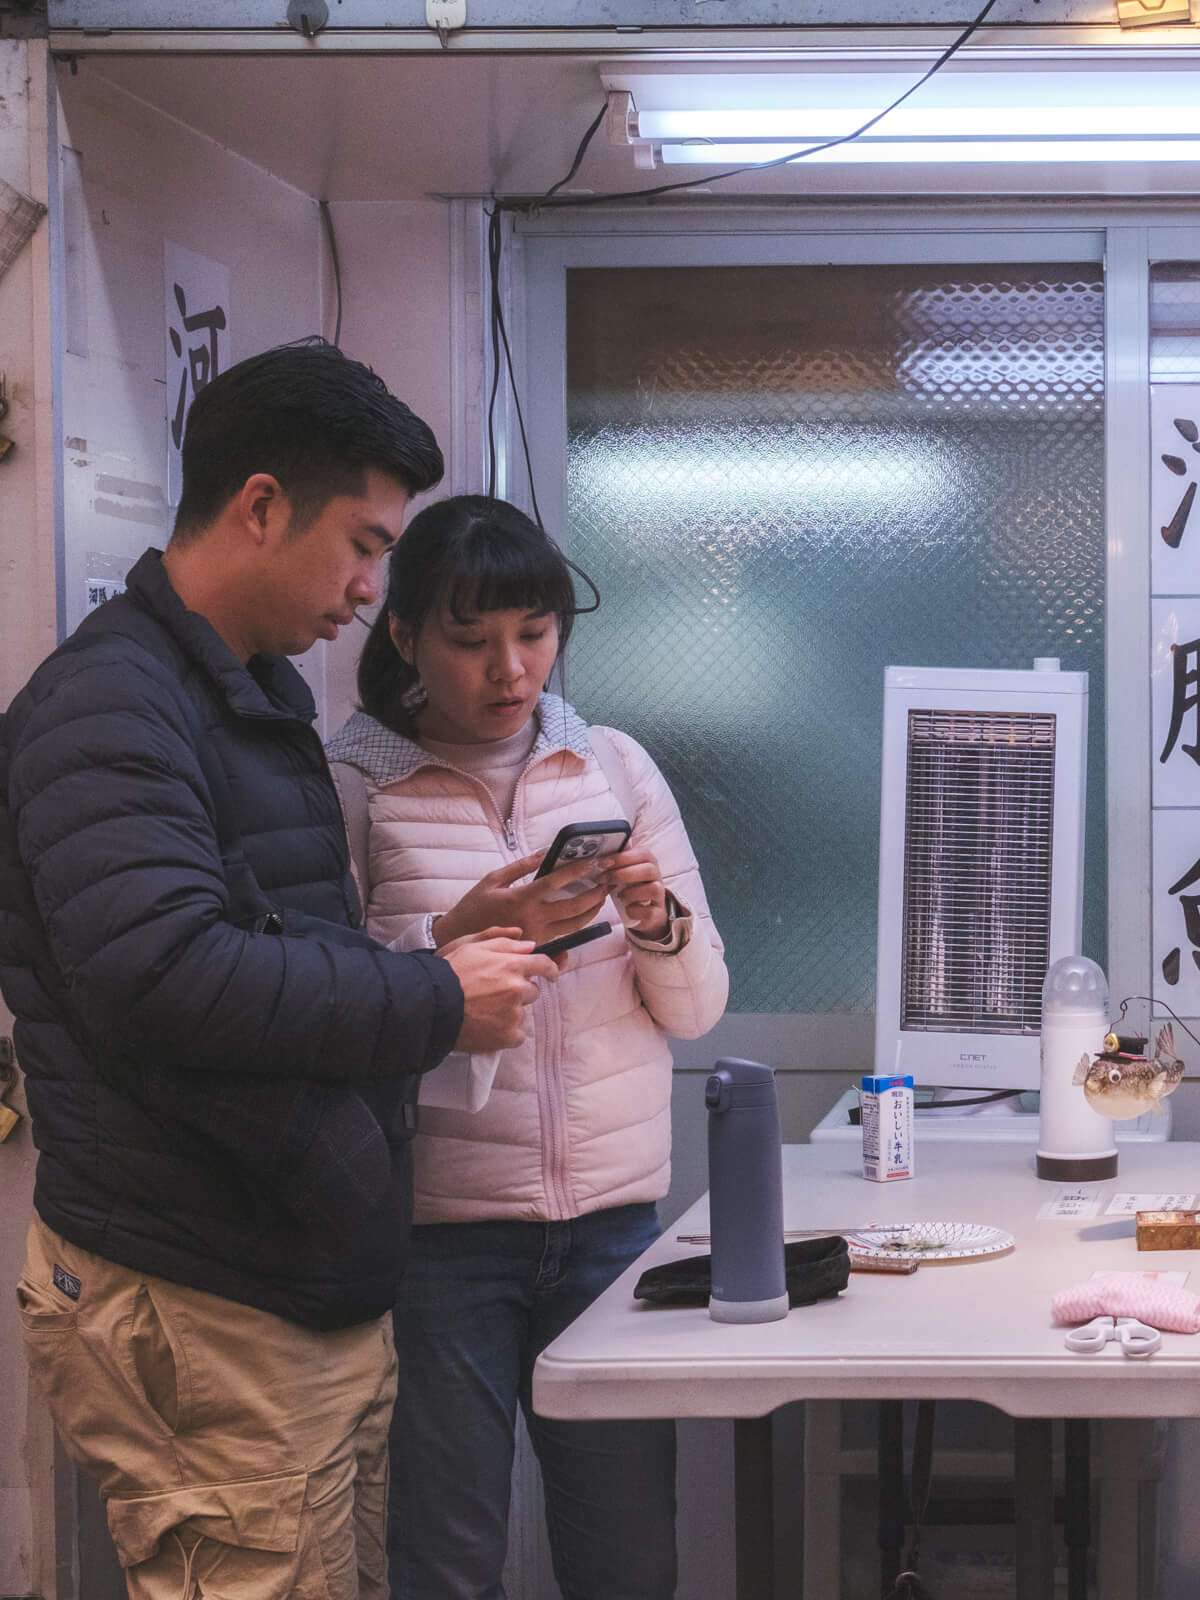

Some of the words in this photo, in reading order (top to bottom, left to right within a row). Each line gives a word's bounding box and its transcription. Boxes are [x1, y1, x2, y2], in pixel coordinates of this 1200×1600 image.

[893, 1099, 904, 1165] おいしい牛乳
